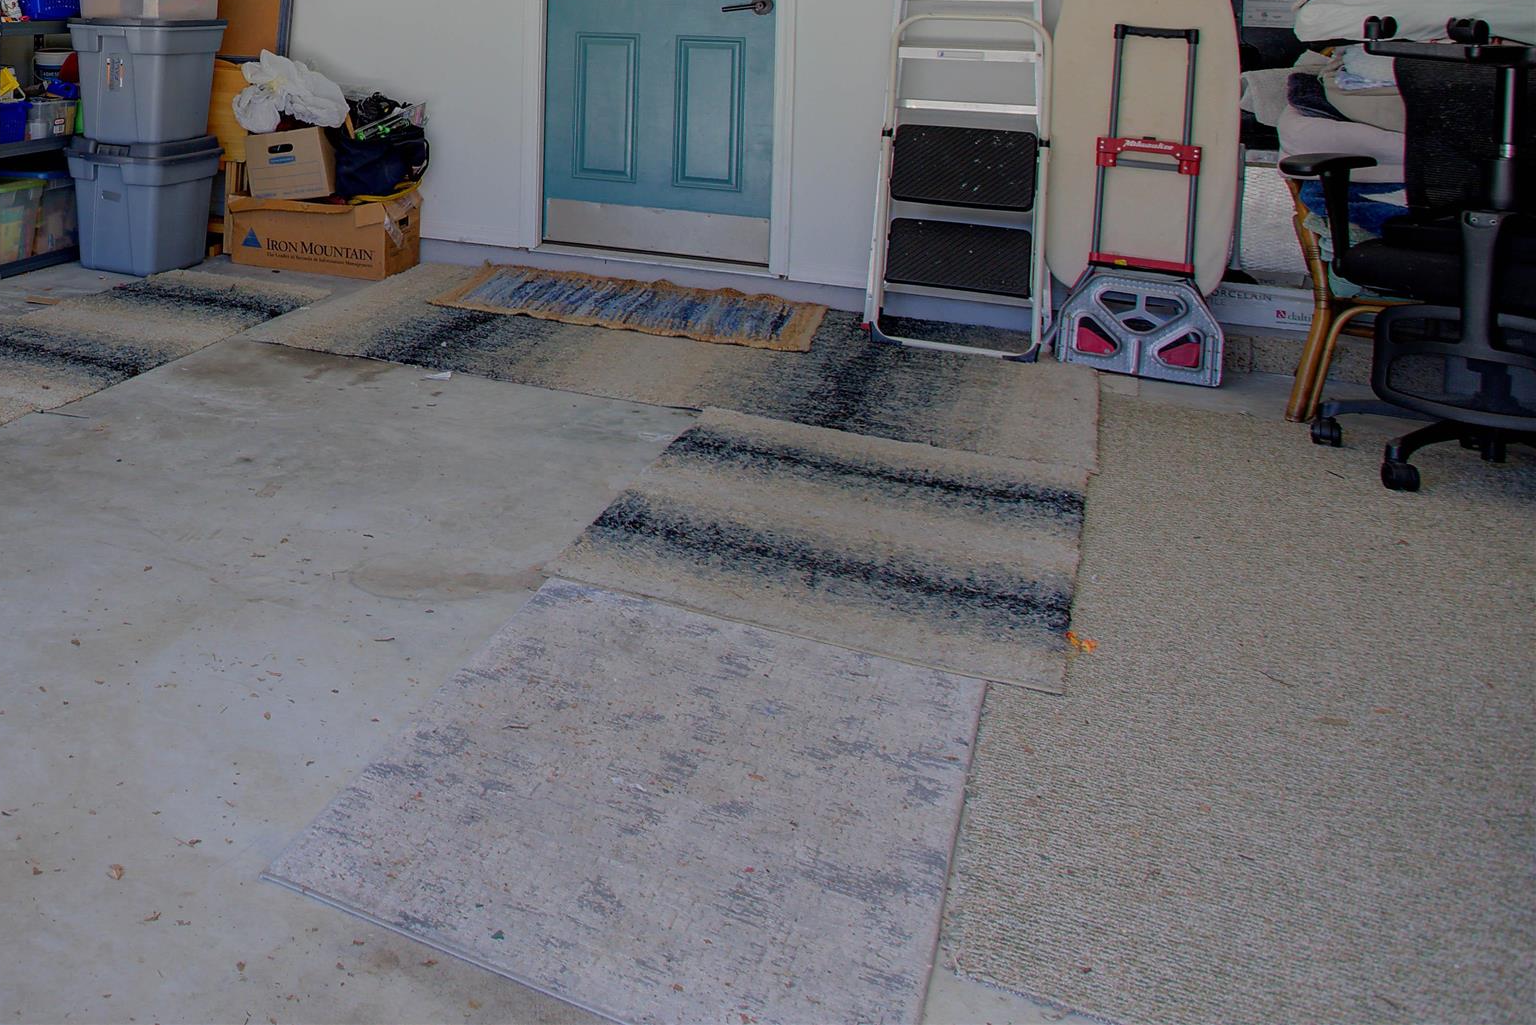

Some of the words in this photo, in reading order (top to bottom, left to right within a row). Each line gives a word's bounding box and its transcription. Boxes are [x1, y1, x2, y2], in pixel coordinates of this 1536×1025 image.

[266, 238, 298, 253] IRON
[301, 241, 373, 261] MOUNTAIN
[1211, 288, 1272, 302] ORCELAIN
